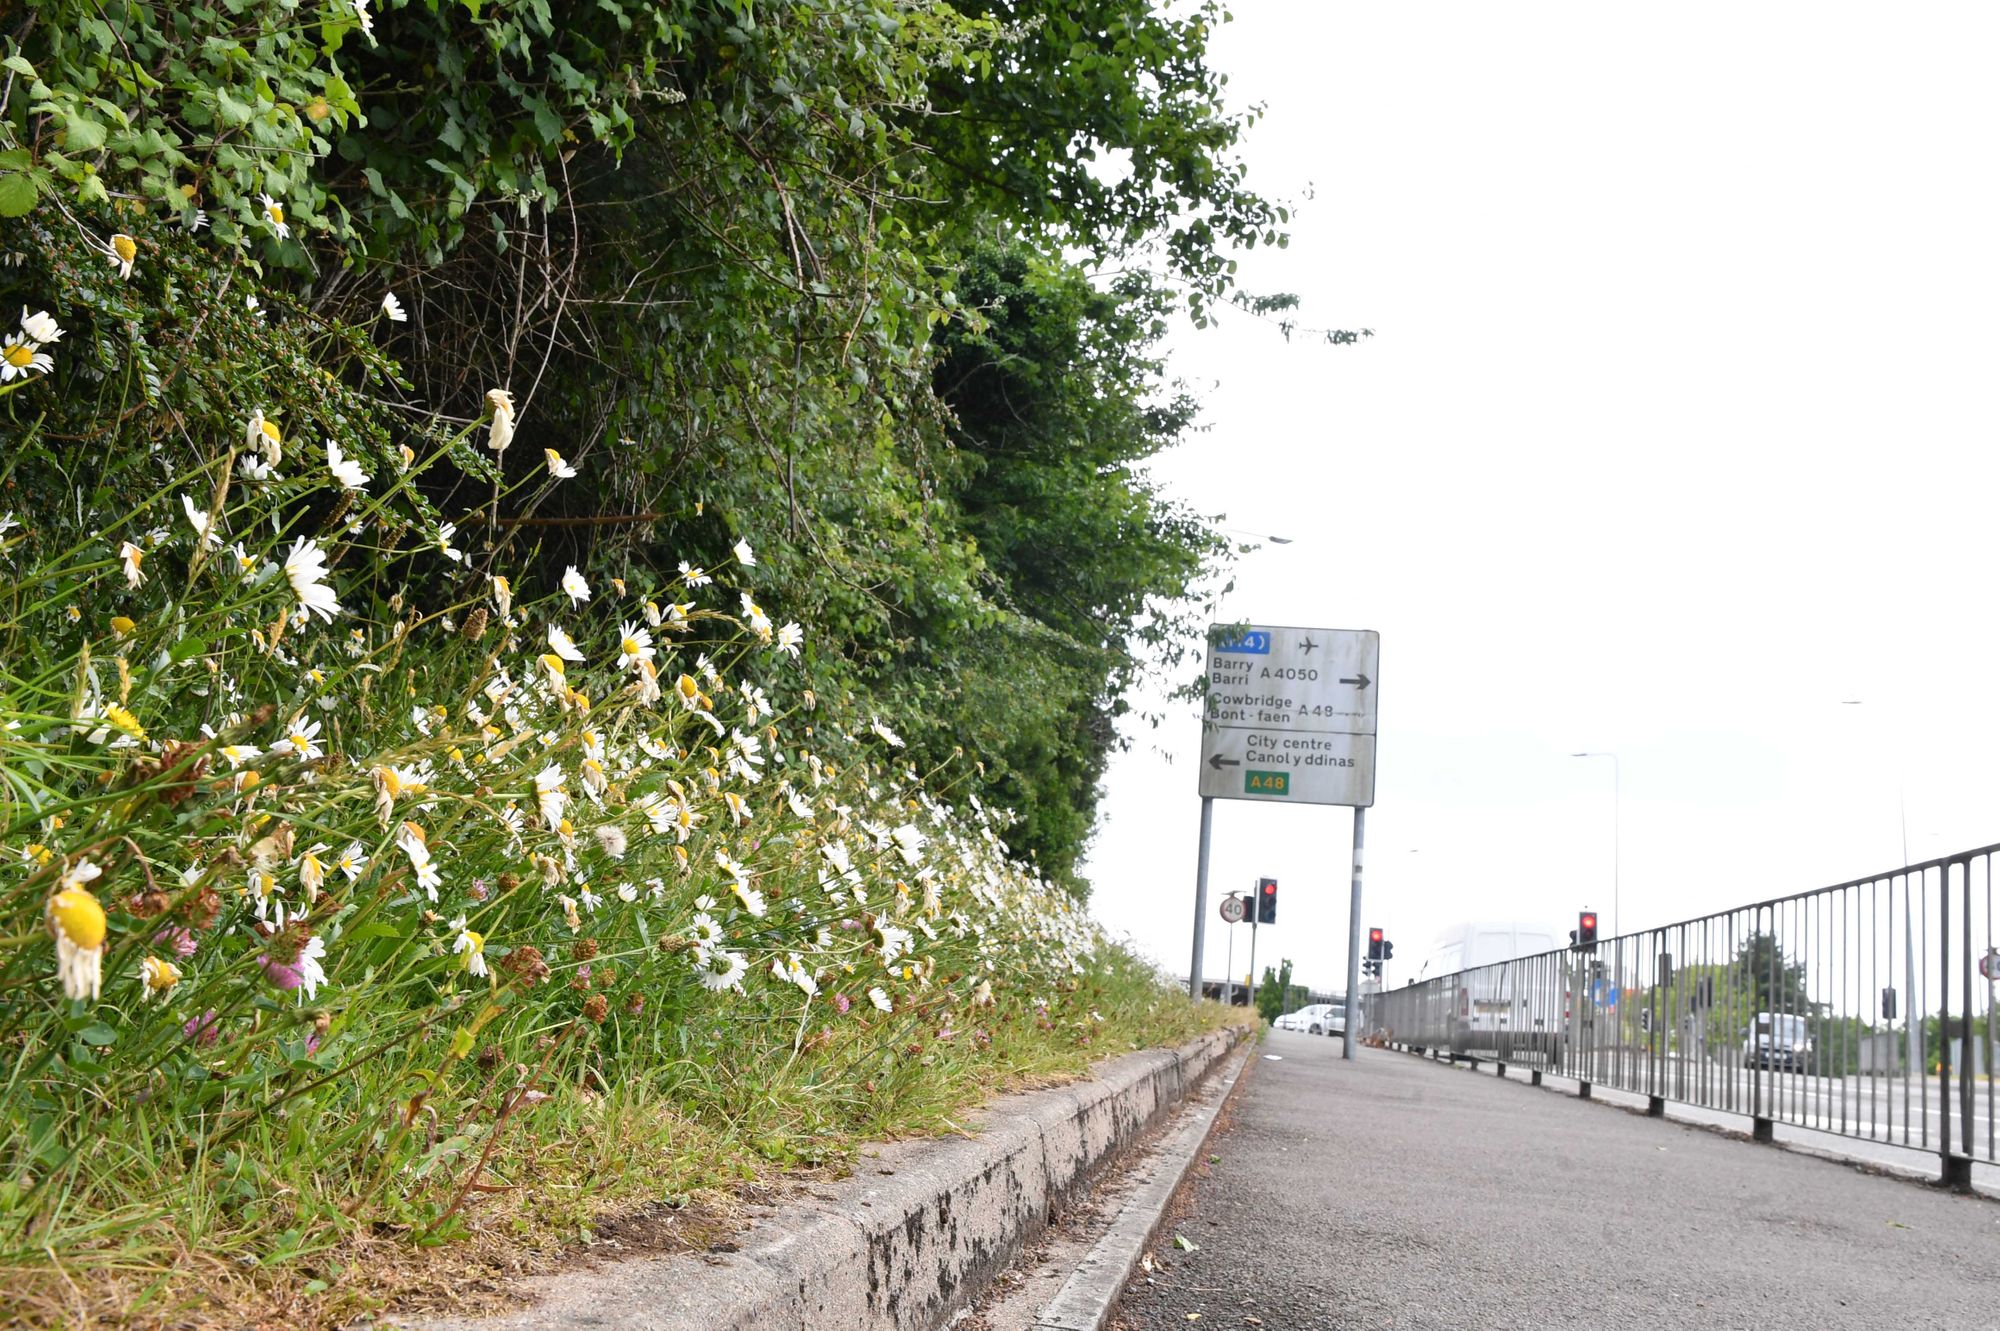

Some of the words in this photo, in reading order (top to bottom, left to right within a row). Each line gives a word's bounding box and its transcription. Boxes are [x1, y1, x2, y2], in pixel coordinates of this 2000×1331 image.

[1213, 657, 1254, 672] Barry
[1212, 672, 1249, 685] Barri
[1212, 692, 1293, 709] Cowbridge
[1247, 734, 1278, 750] City
[1283, 738, 1332, 751] centre
[1246, 750, 1290, 764] Canol
[1293, 755, 1301, 767] y
[1305, 754, 1355, 768] ddinas
[1225, 903, 1242, 916] 40
